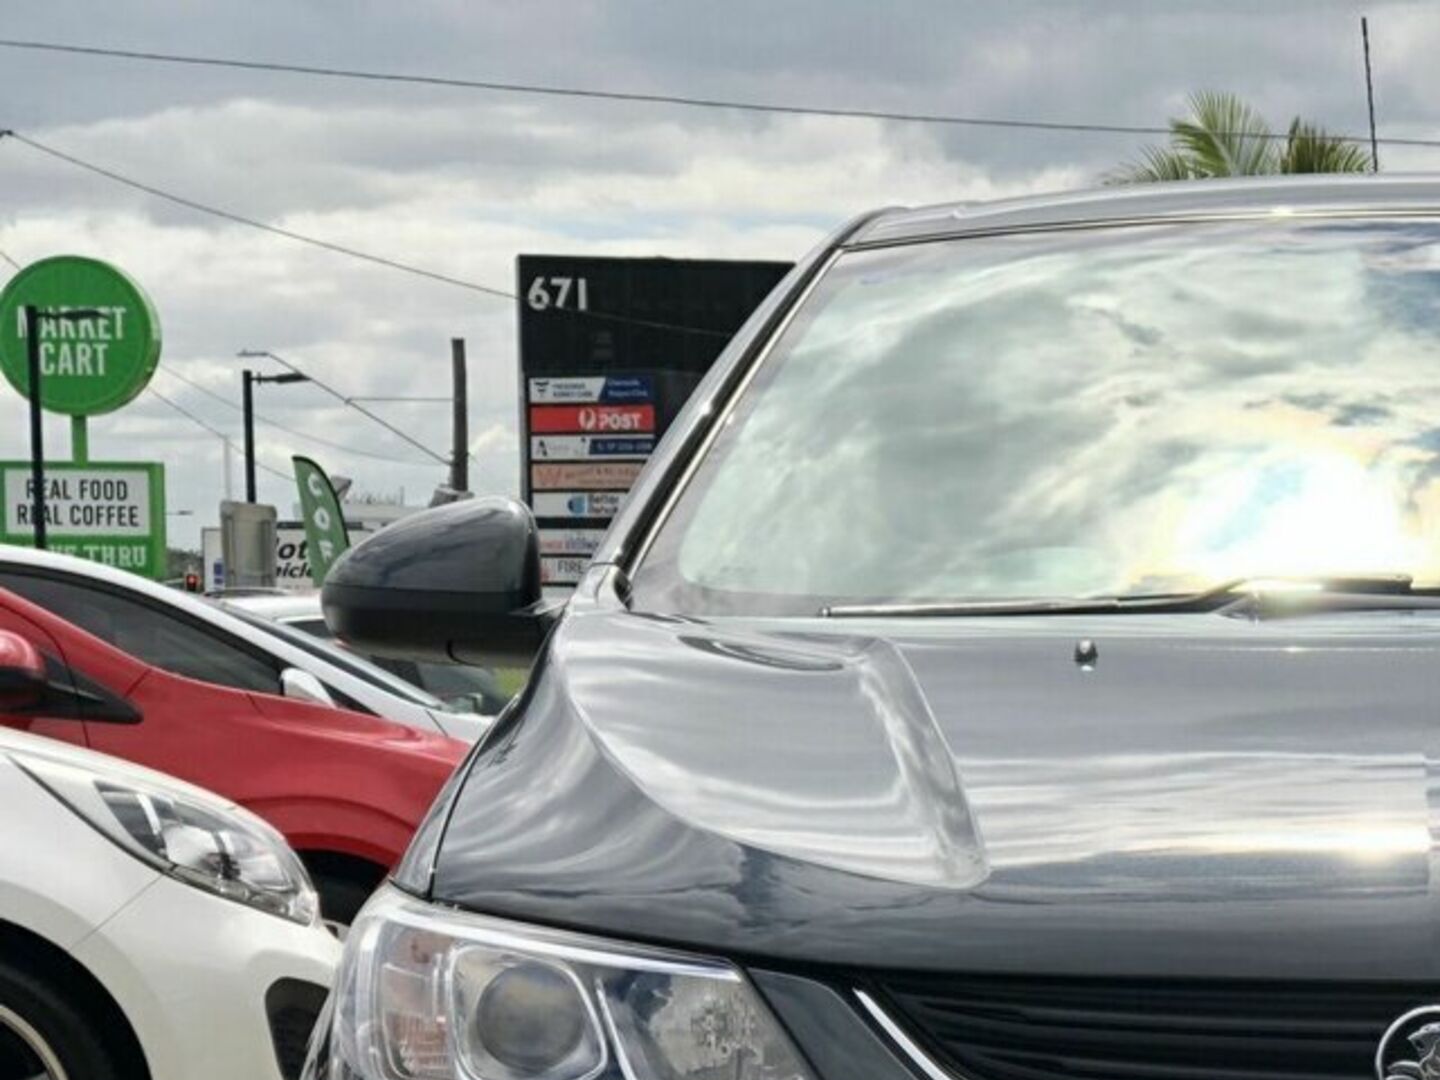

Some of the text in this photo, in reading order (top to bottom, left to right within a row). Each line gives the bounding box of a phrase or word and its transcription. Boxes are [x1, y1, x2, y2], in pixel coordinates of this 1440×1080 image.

[527, 276, 588, 311] 671
[40, 341, 108, 376] CART
[598, 413, 641, 430] POST
[79, 479, 128, 501] FOOD
[69, 505, 139, 527] COFFEE
[83, 544, 146, 567] THRU
